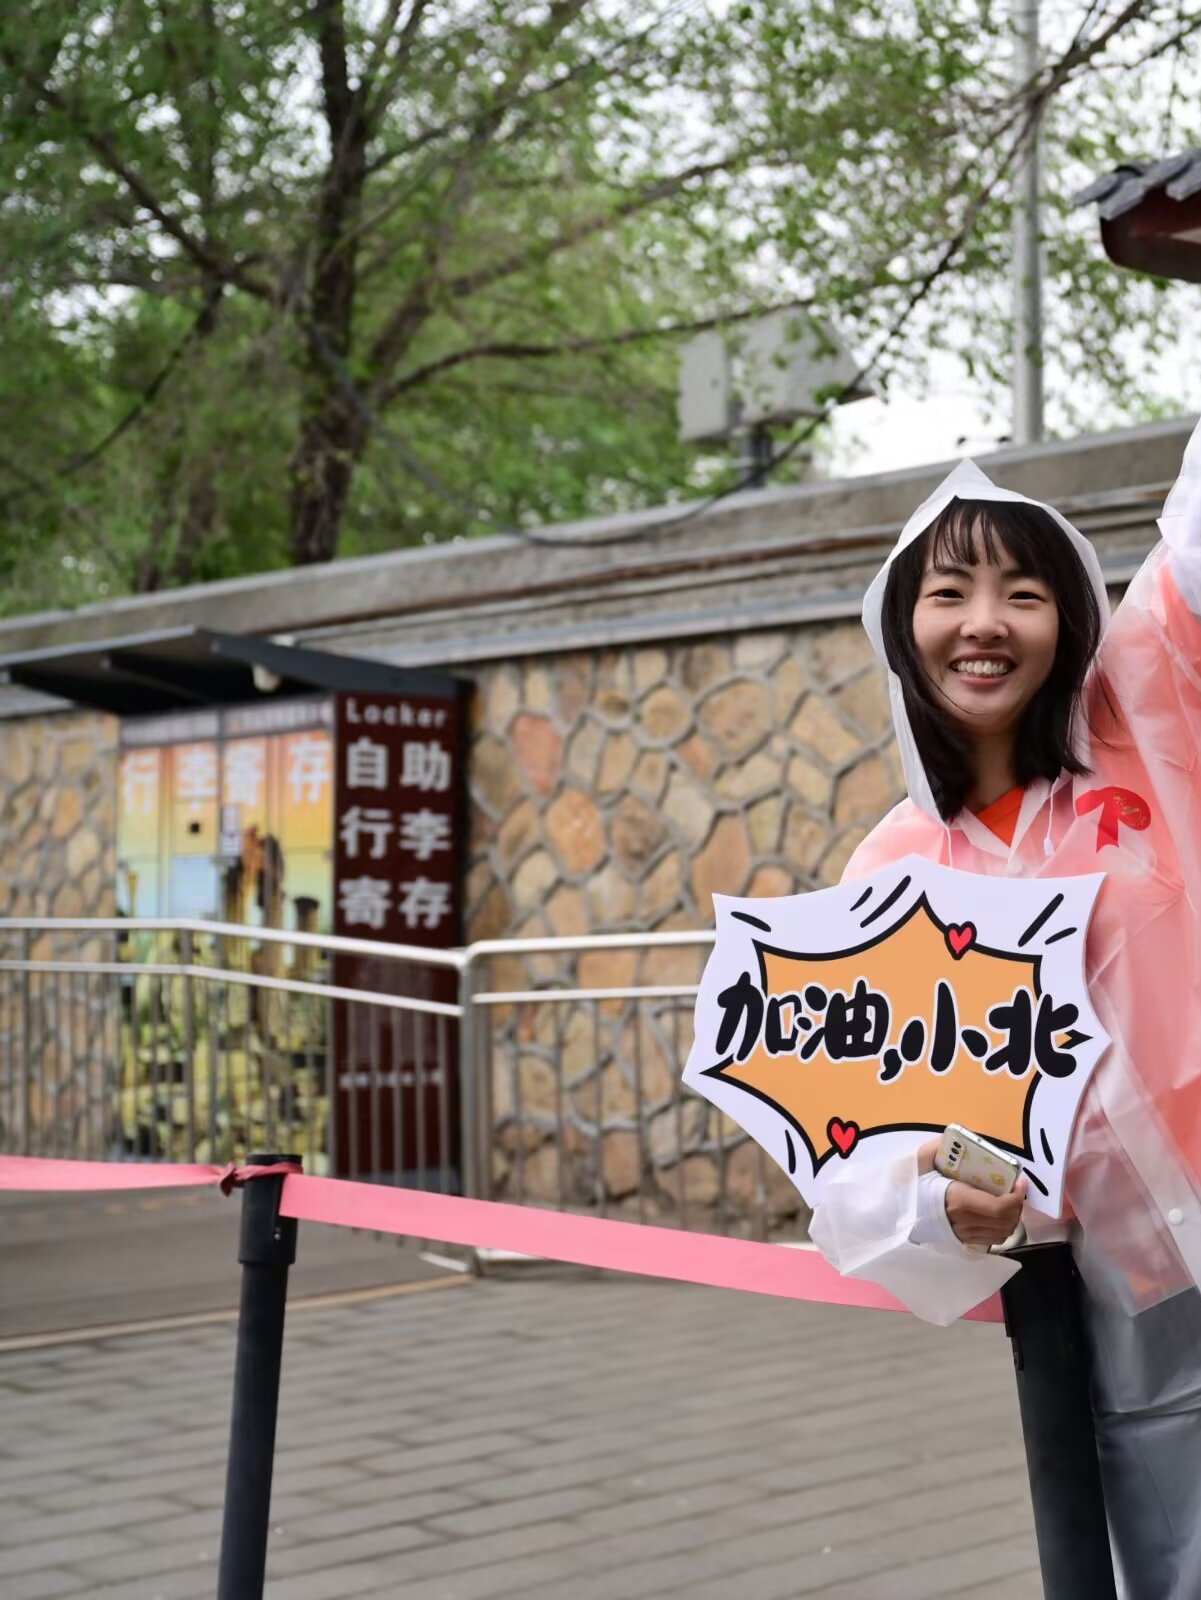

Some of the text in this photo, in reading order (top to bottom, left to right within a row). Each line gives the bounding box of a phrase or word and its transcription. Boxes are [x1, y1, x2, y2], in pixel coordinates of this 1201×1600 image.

[346, 697, 448, 728] Locker
[122, 733, 332, 816] 行李寄存
[346, 736, 452, 792] 自助
[340, 806, 453, 862] 行李
[338, 875, 453, 929] 寄存
[716, 970, 1080, 1081] 加油，小北
